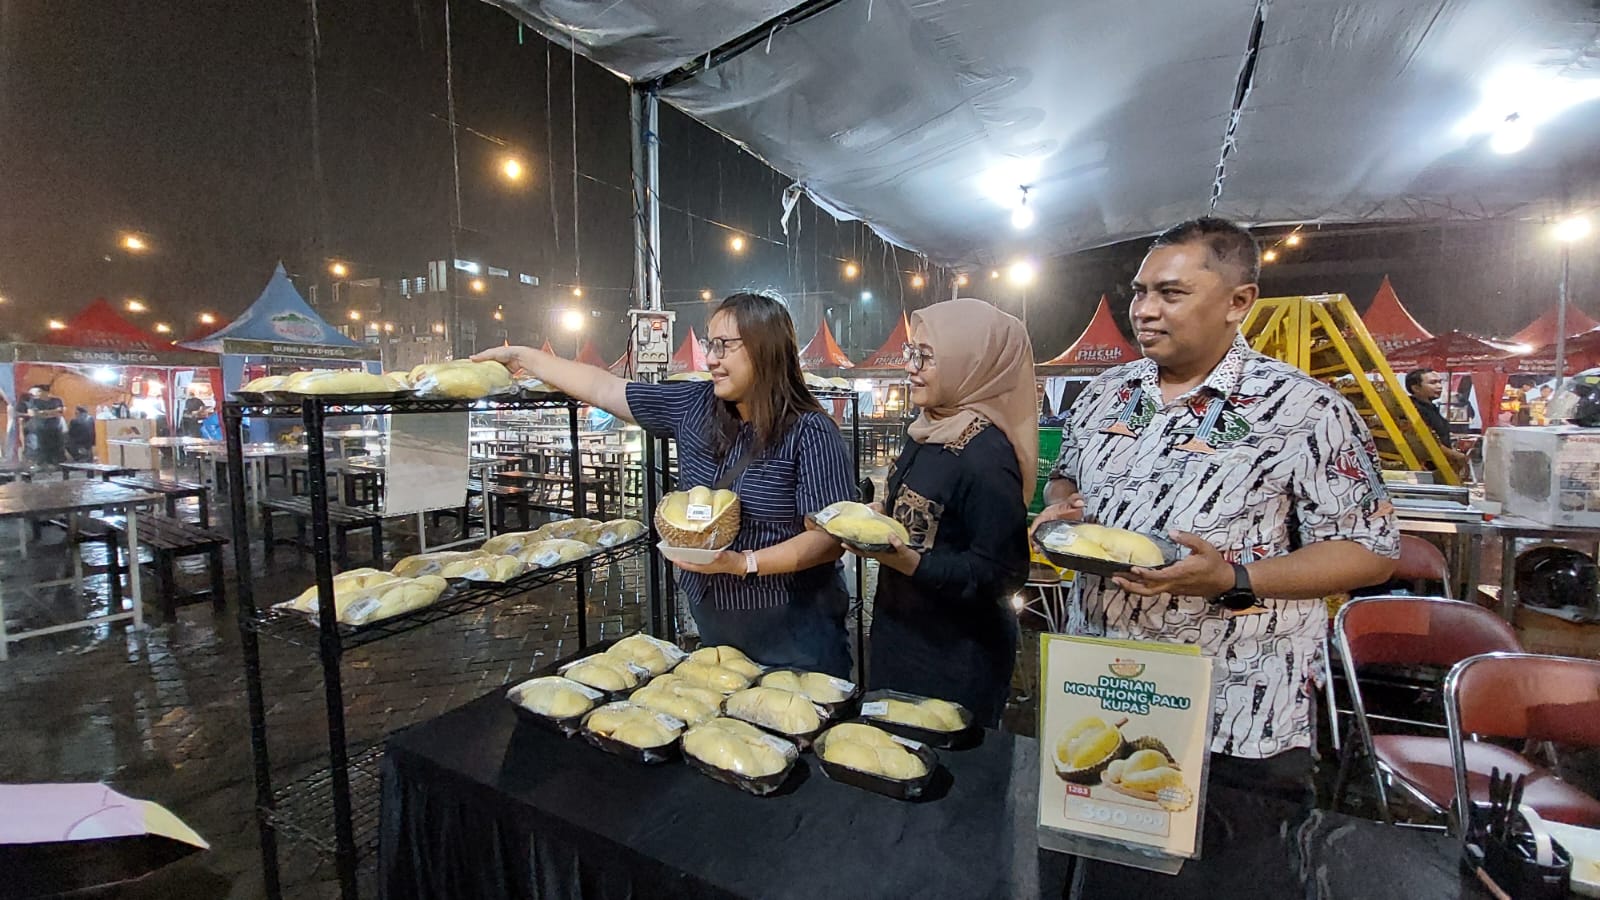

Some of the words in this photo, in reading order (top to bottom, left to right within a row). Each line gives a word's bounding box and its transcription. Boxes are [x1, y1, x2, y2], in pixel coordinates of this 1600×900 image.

[73, 351, 113, 361] BANK
[118, 352, 158, 362] MEGA
[1099, 677, 1155, 693] DURIAN
[1064, 683, 1148, 703] MONTHONG
[1151, 695, 1190, 709] PALU
[1102, 700, 1149, 714] KUPAS
